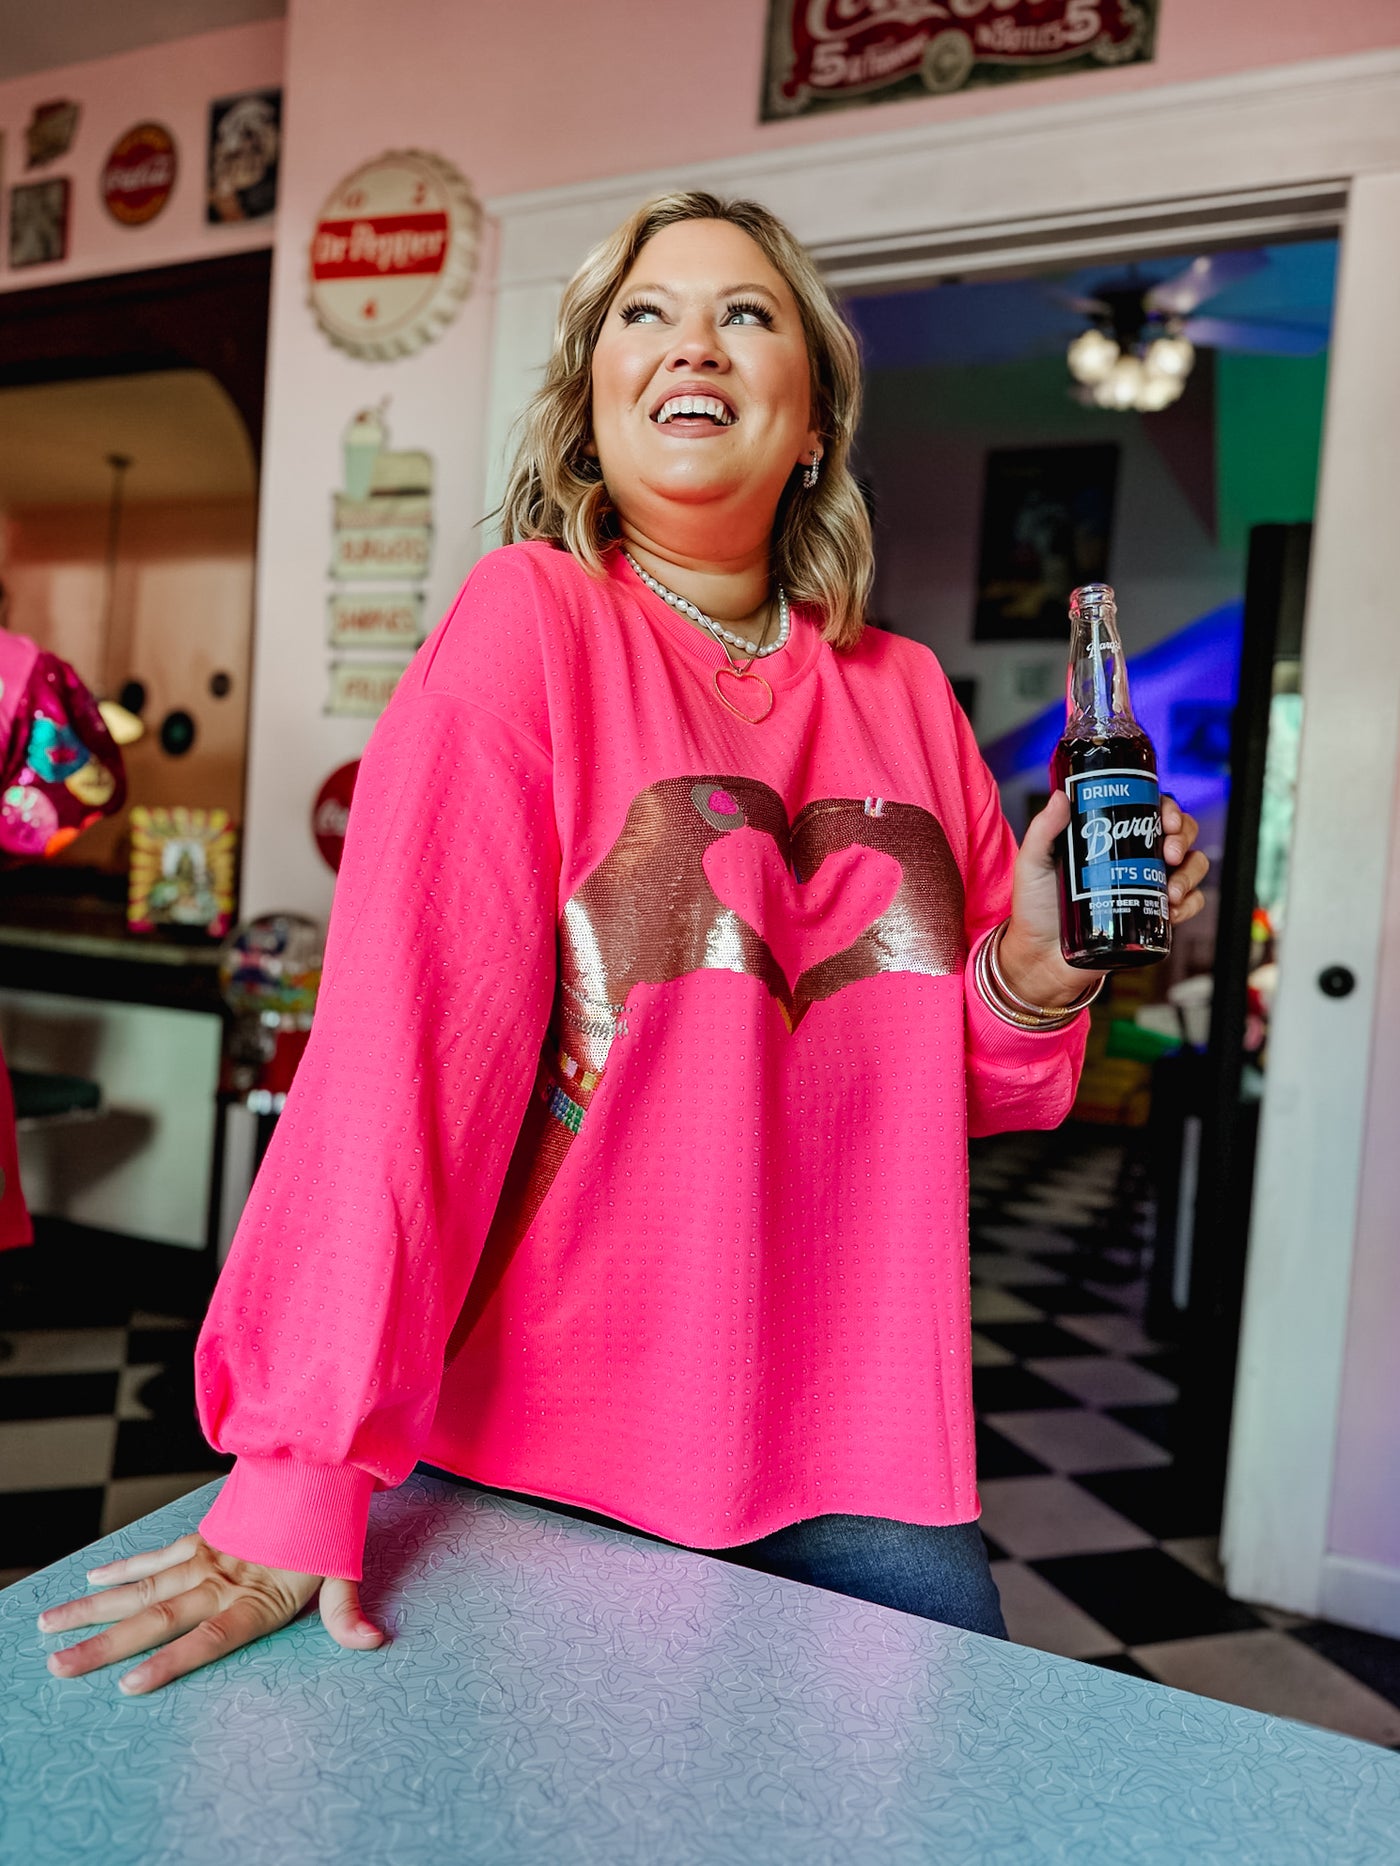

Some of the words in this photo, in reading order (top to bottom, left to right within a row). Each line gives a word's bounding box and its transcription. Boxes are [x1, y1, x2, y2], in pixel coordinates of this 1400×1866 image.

[809, 41, 849, 87] 5
[313, 232, 347, 264] Dr
[349, 221, 445, 271] Pepper
[1082, 784, 1130, 800] DRINK
[1110, 867, 1138, 880] IT'S
[1089, 901, 1114, 910] ROOT
[1116, 899, 1140, 907] BEER
